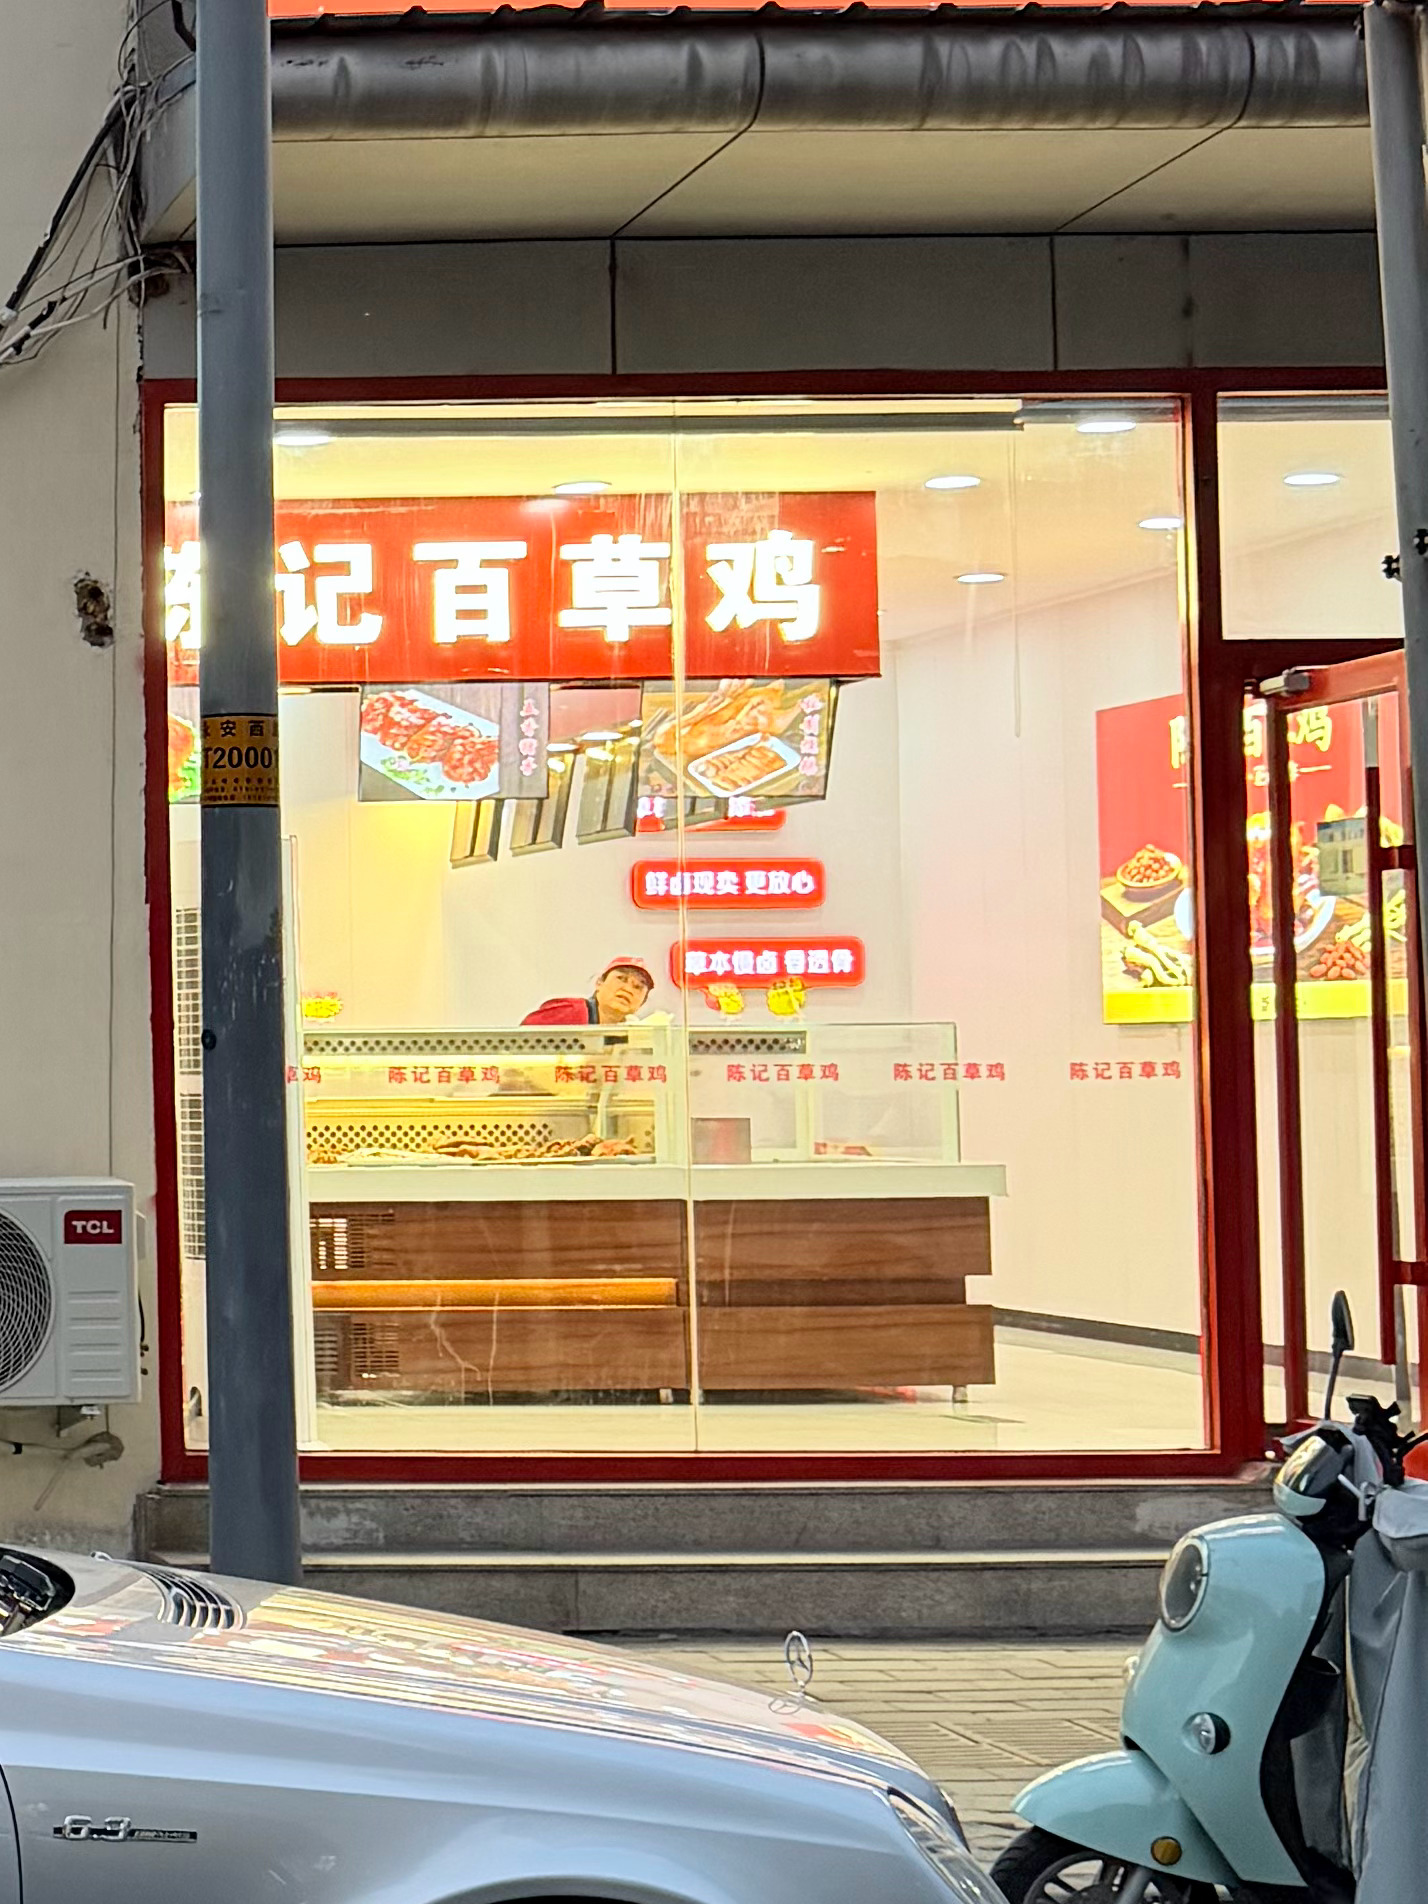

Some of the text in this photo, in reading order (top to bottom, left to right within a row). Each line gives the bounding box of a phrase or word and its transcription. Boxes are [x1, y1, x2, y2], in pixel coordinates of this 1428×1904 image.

[204, 746, 278, 769] T2000
[387, 1064, 502, 1084] 陈记百草鸡
[554, 1064, 668, 1084] 陈记百草鸡
[726, 1062, 840, 1082] 陈记百草鸡
[892, 1061, 1007, 1082] 陈记百草鸡
[1068, 1060, 1183, 1081] 陈记百草鸡
[71, 1220, 114, 1235] TCL
